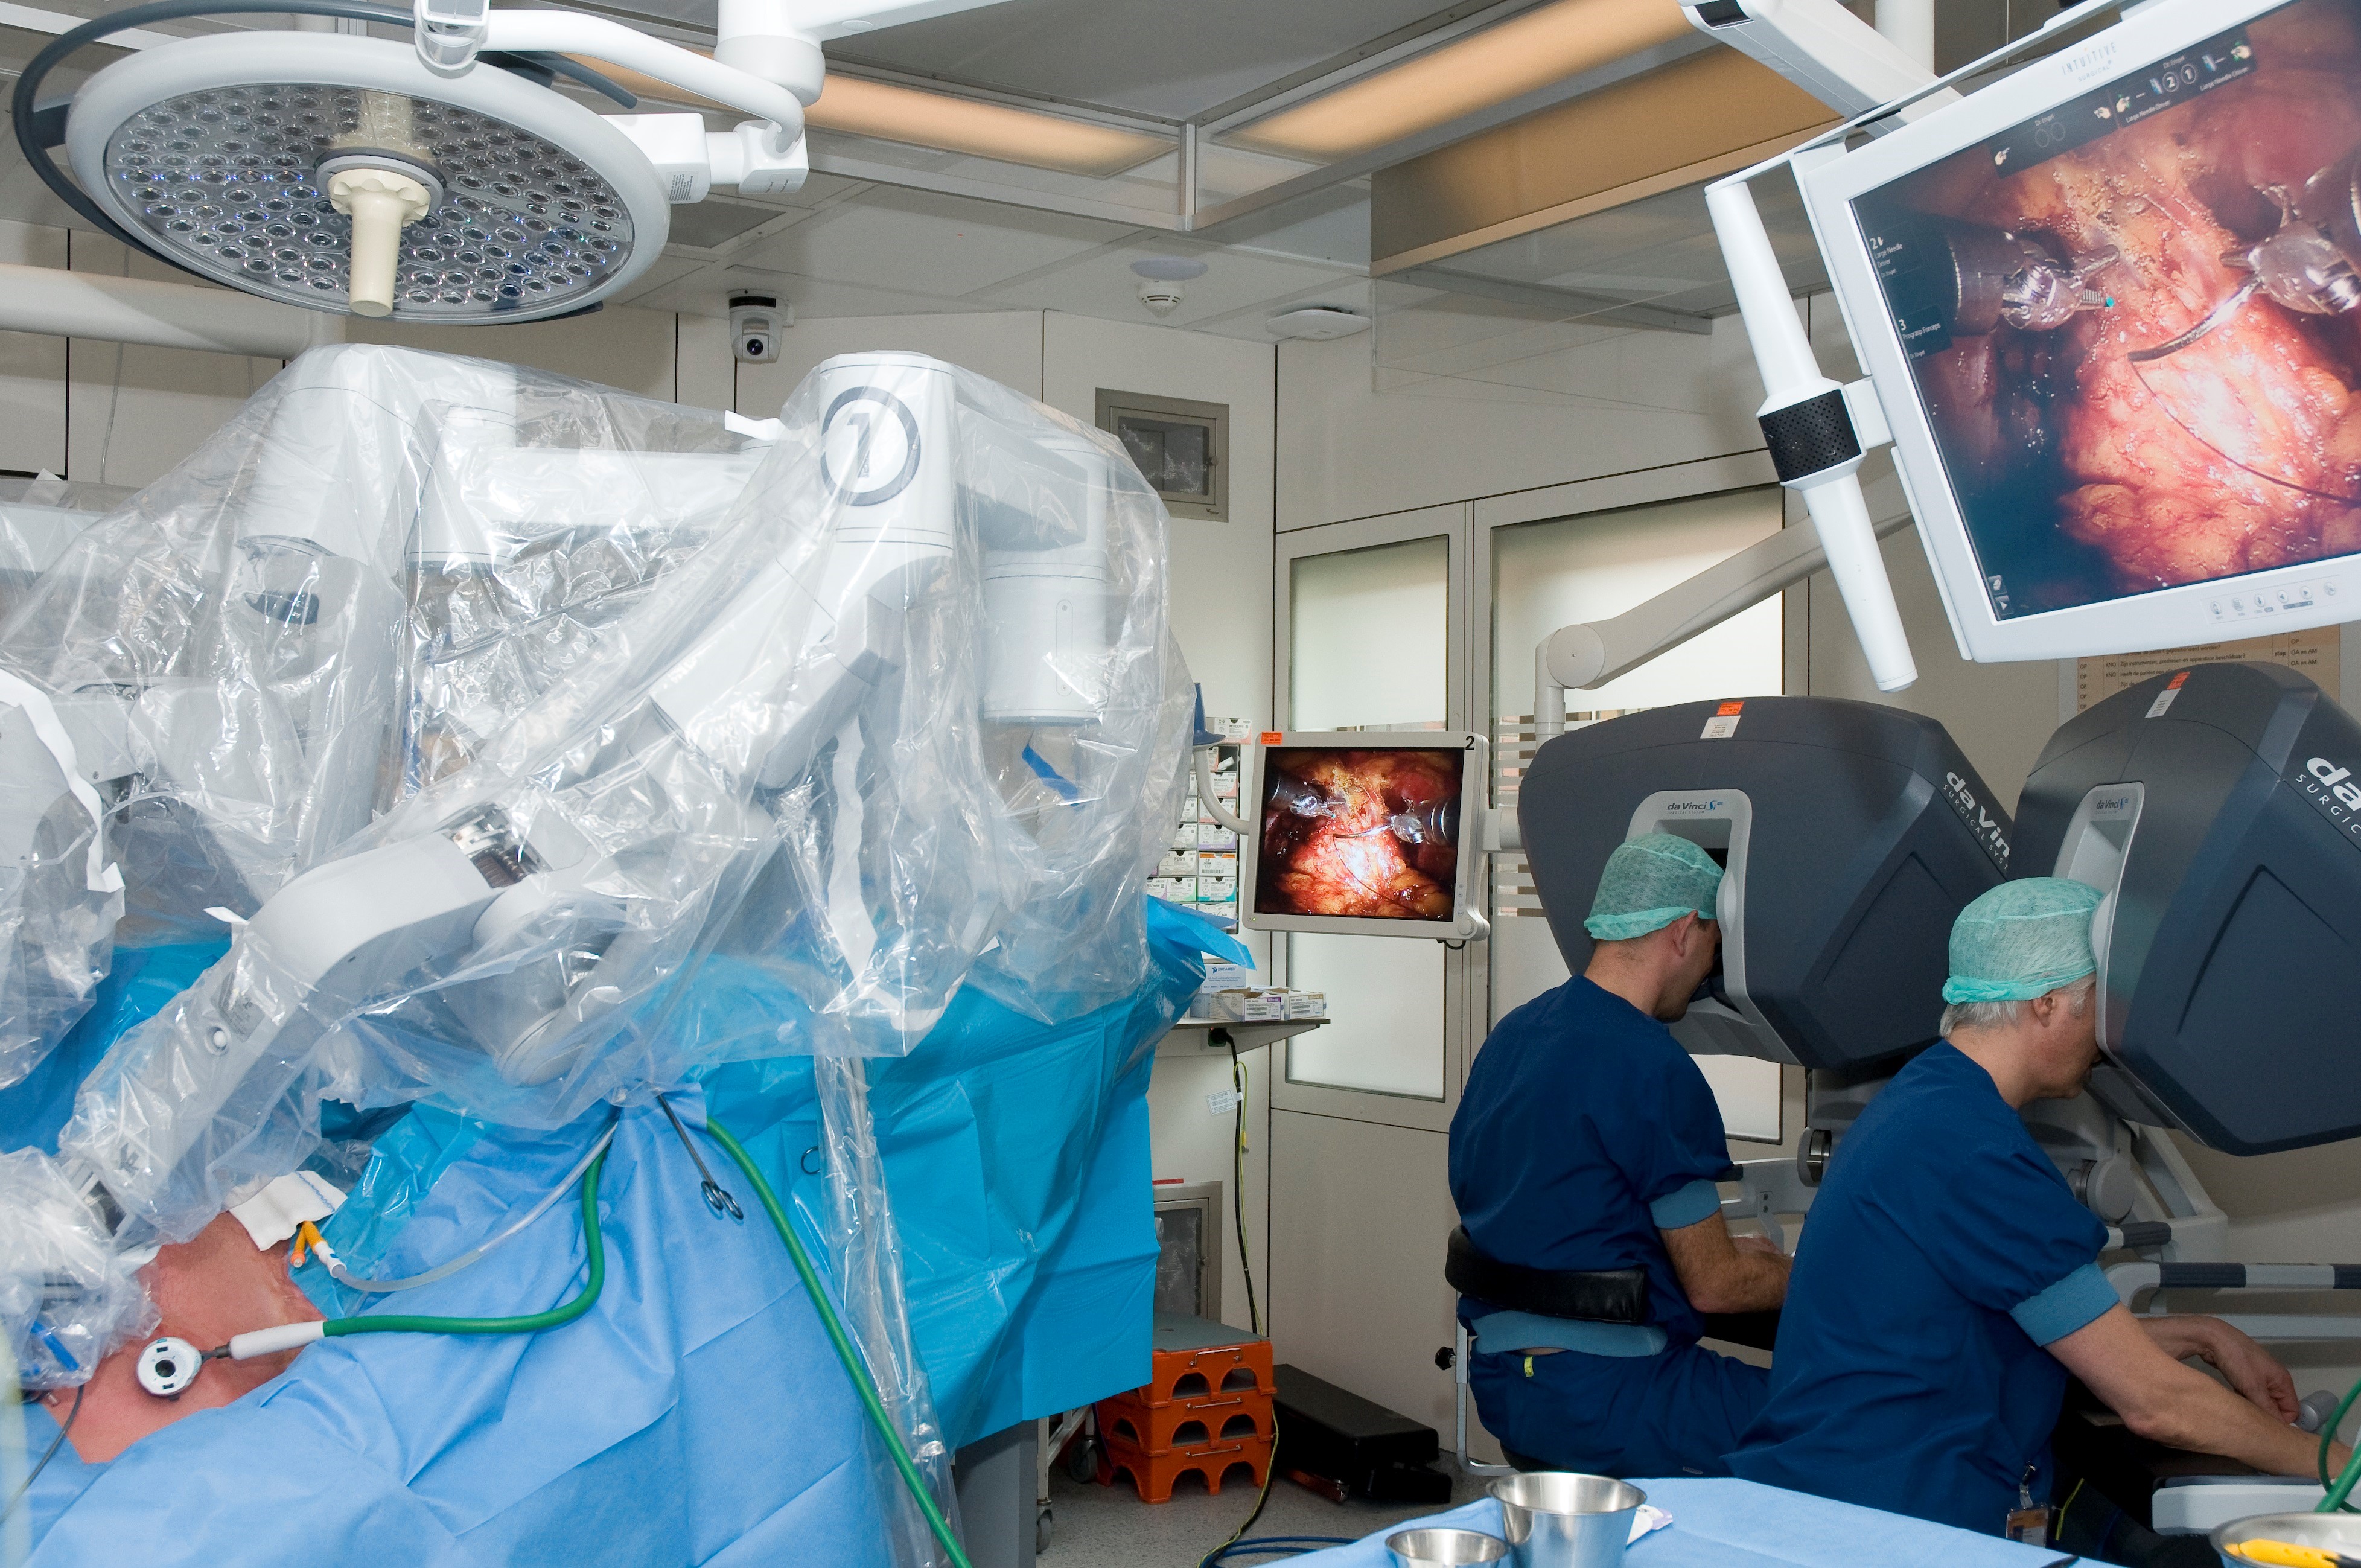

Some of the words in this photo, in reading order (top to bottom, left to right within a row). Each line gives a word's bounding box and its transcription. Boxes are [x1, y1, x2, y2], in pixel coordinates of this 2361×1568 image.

[2061, 42, 2117, 75] INTUITIVE
[2166, 76, 2176, 88] 2
[2184, 68, 2194, 80] 1
[2199, 81, 2215, 91] Large
[2214, 73, 2232, 84] Needle
[2231, 66, 2251, 77] Driver
[2125, 113, 2140, 123] Large
[2139, 106, 2156, 117] Needle
[2155, 100, 2171, 110] Driver
[1870, 237, 1878, 250] 2
[1886, 243, 1903, 253] Needle
[1898, 319, 1907, 331] 3
[1922, 323, 1941, 333] Forceps
[846, 412, 870, 479] 1
[1465, 735, 1474, 750] 2
[1946, 771, 1975, 810] da
[2306, 757, 2361, 811] da
[1681, 801, 1707, 810] Vinci
[1943, 783, 1984, 840] SURGICAL
[2295, 774, 2361, 840] SURGIC
